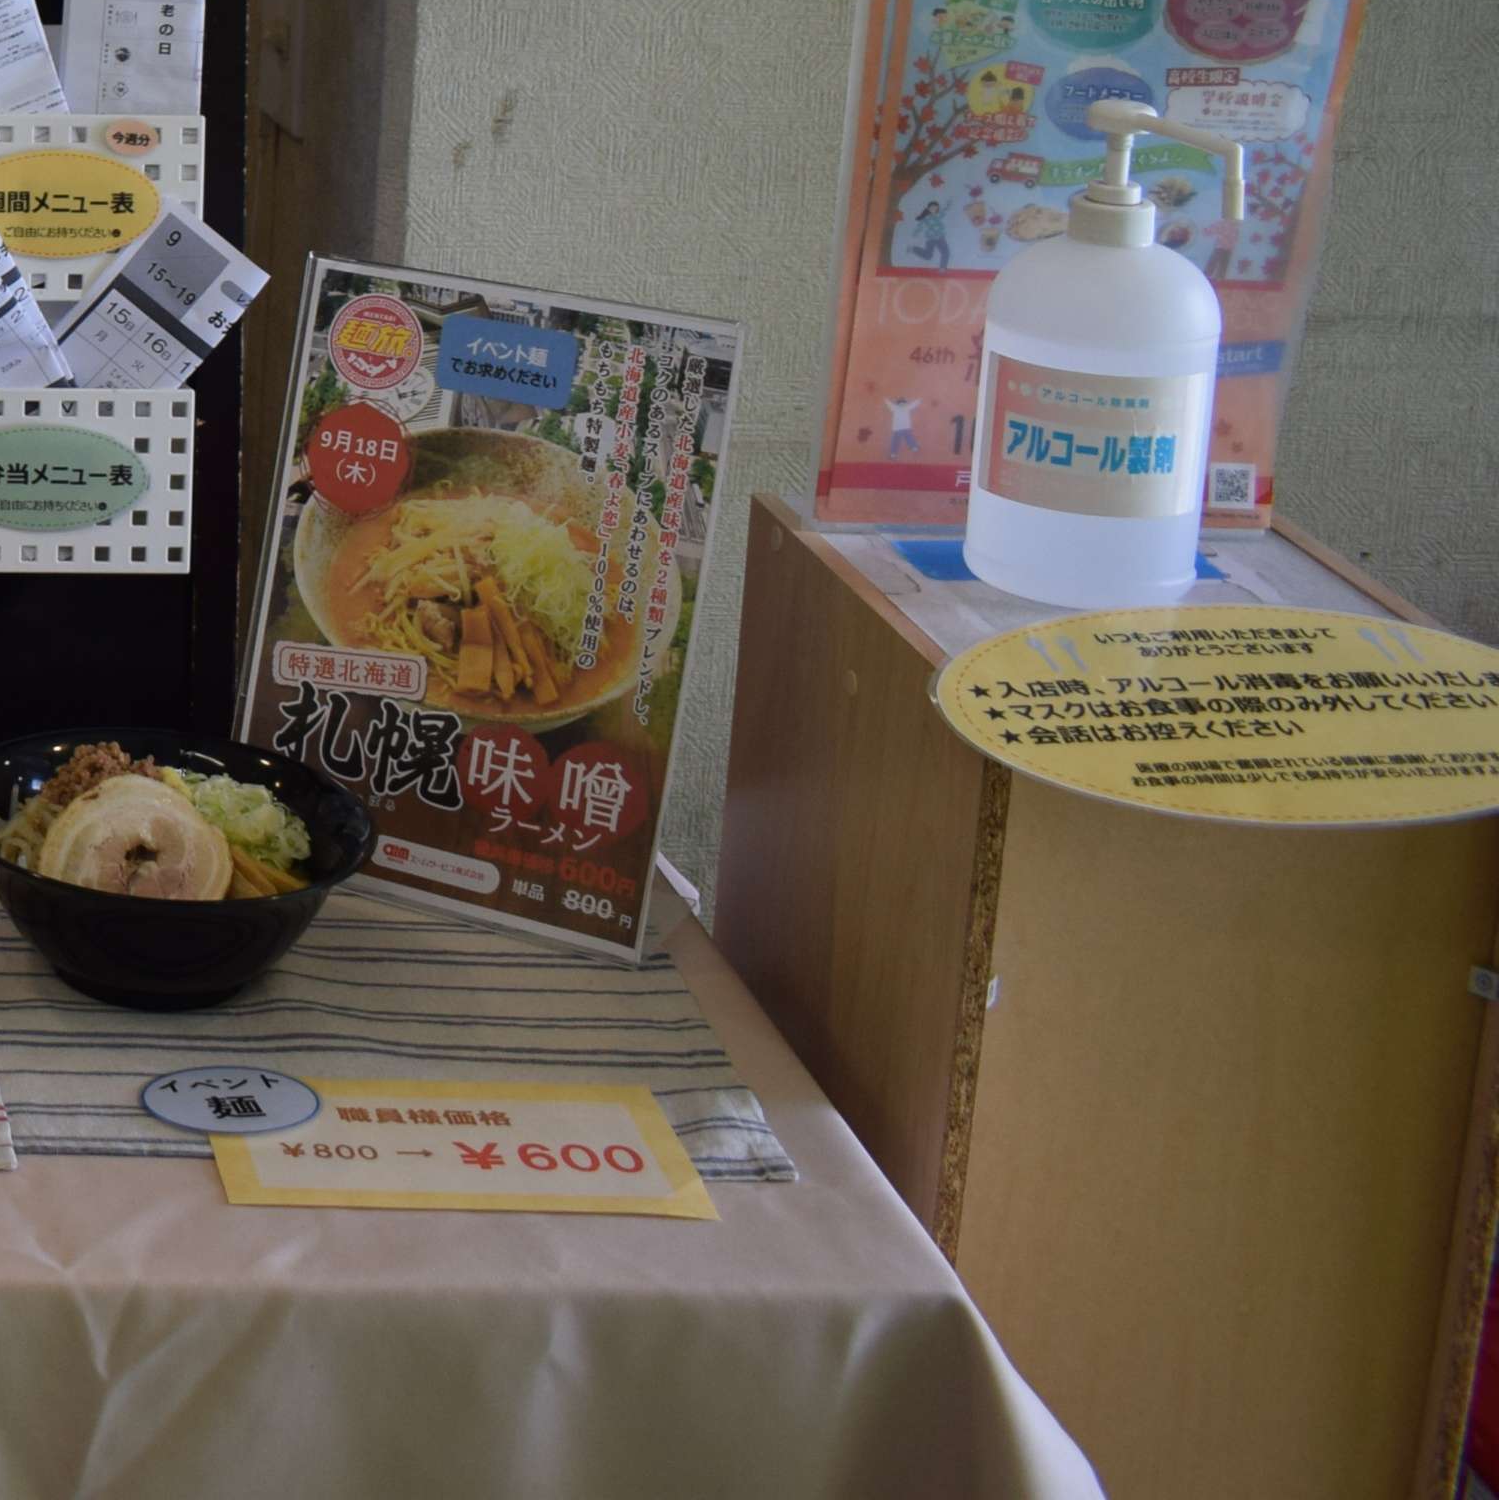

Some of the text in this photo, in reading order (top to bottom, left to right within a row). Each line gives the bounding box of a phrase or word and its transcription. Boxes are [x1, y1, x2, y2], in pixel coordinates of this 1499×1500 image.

[166, 230, 182, 247] 9
[465, 336, 549, 369] イベント麺
[908, 345, 956, 366] 46th
[449, 355, 558, 391] でお求めください
[320, 429, 399, 463] 9月18日
[1006, 418, 1177, 476] アルコール製剤
[1139, 642, 1315, 658] ありがとうございます
[286, 651, 416, 690] 特選北海道
[1014, 693, 1499, 721] マスクはお食事の際のみ外してください
[273, 680, 465, 812] 札幌
[1028, 720, 1305, 746] 会話はお控えください
[466, 736, 632, 834] 味噌
[487, 807, 603, 852] ラーメン
[511, 878, 545, 903] 単品
[158, 1072, 286, 1095] イベント
[206, 1094, 268, 1121] 麺
[336, 1106, 513, 1128] 職員様価格
[279, 1140, 645, 1174] ¥800 ¥600
